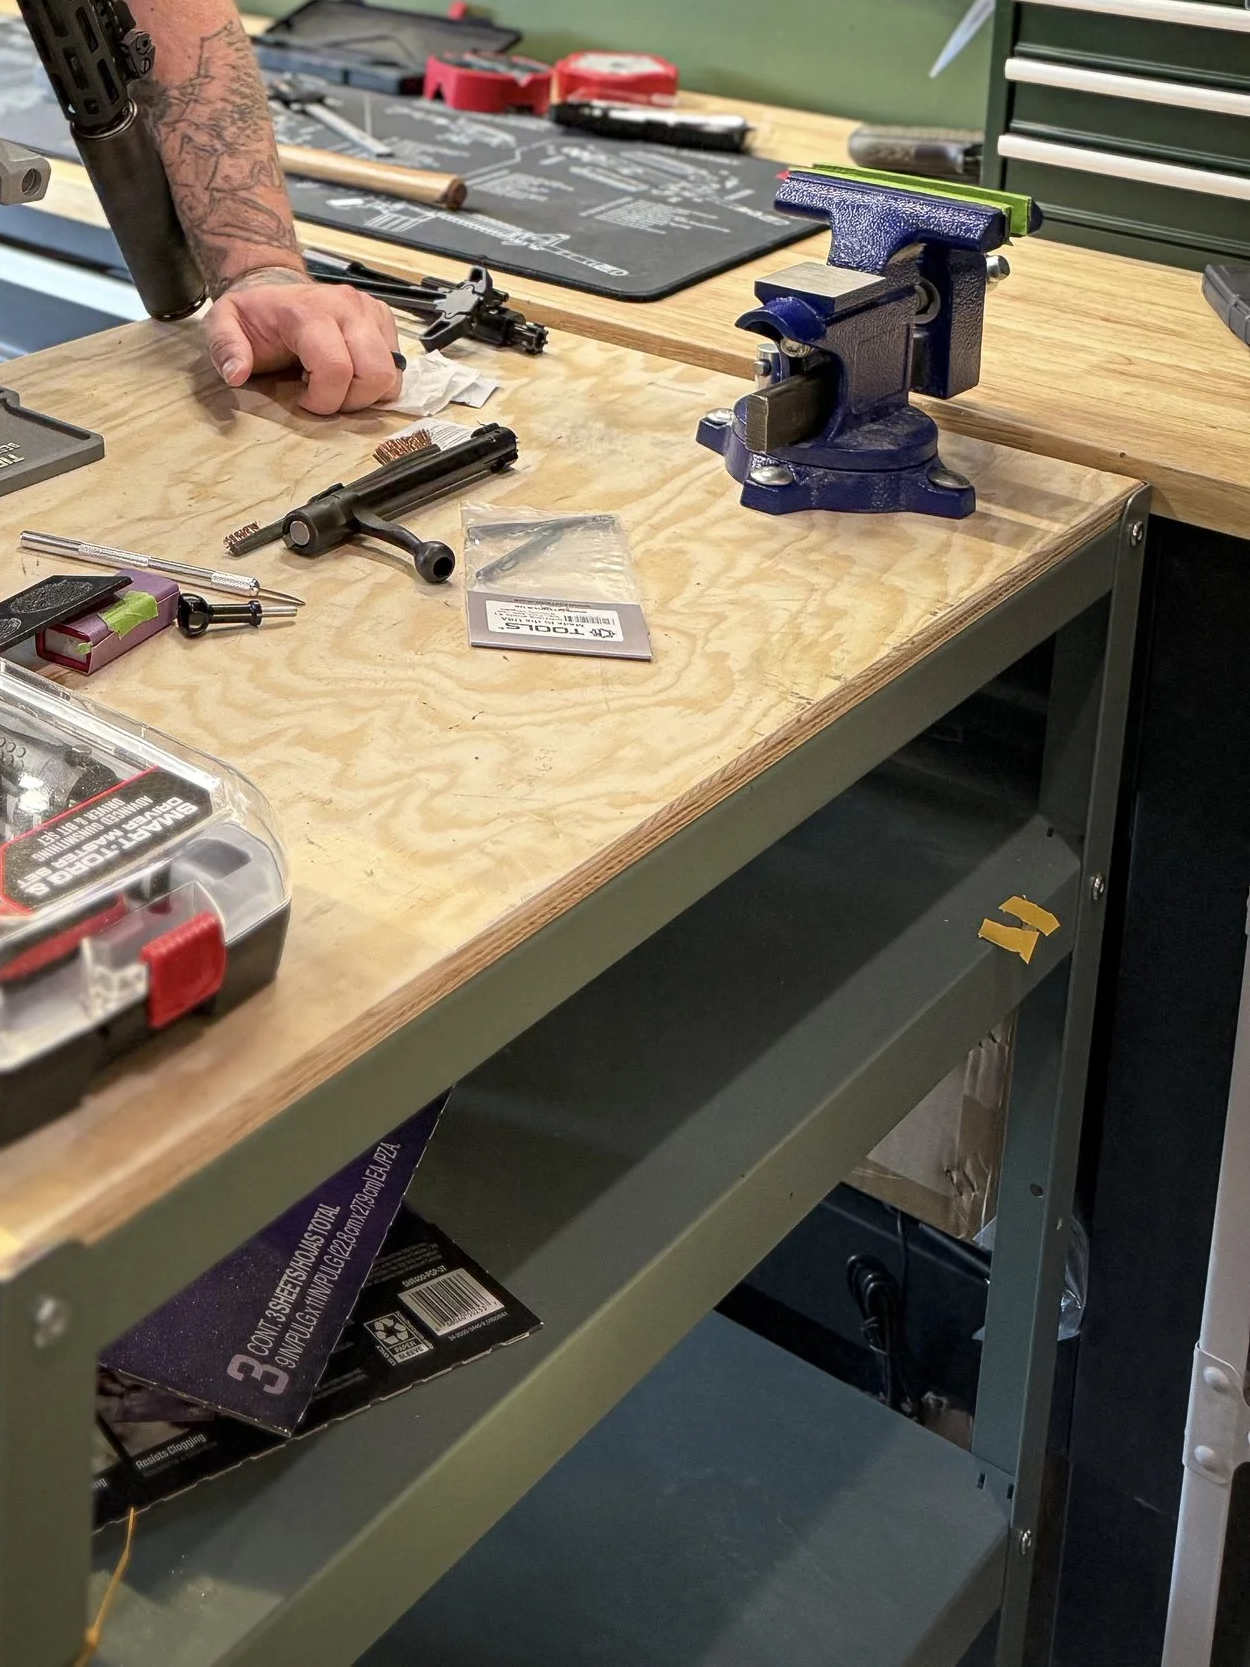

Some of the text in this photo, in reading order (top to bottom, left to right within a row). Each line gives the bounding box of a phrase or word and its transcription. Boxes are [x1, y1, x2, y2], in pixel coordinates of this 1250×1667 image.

[504, 621, 585, 636] TOOLS
[30, 794, 155, 863] ADVANCED GUNSMITHING
[36, 797, 125, 847] DRIVER & BIT SET
[17, 796, 185, 890] DRIVER MASTER SET
[24, 882, 51, 897] &
[247, 1319, 280, 1356] CONT.
[307, 1204, 341, 1239] TOTAL
[394, 1339, 417, 1354] PAPER
[397, 1344, 426, 1361] SLEEVE
[227, 1353, 289, 1396] 3
[135, 1449, 169, 1470] Resists
[167, 1432, 206, 1455] Clogging
